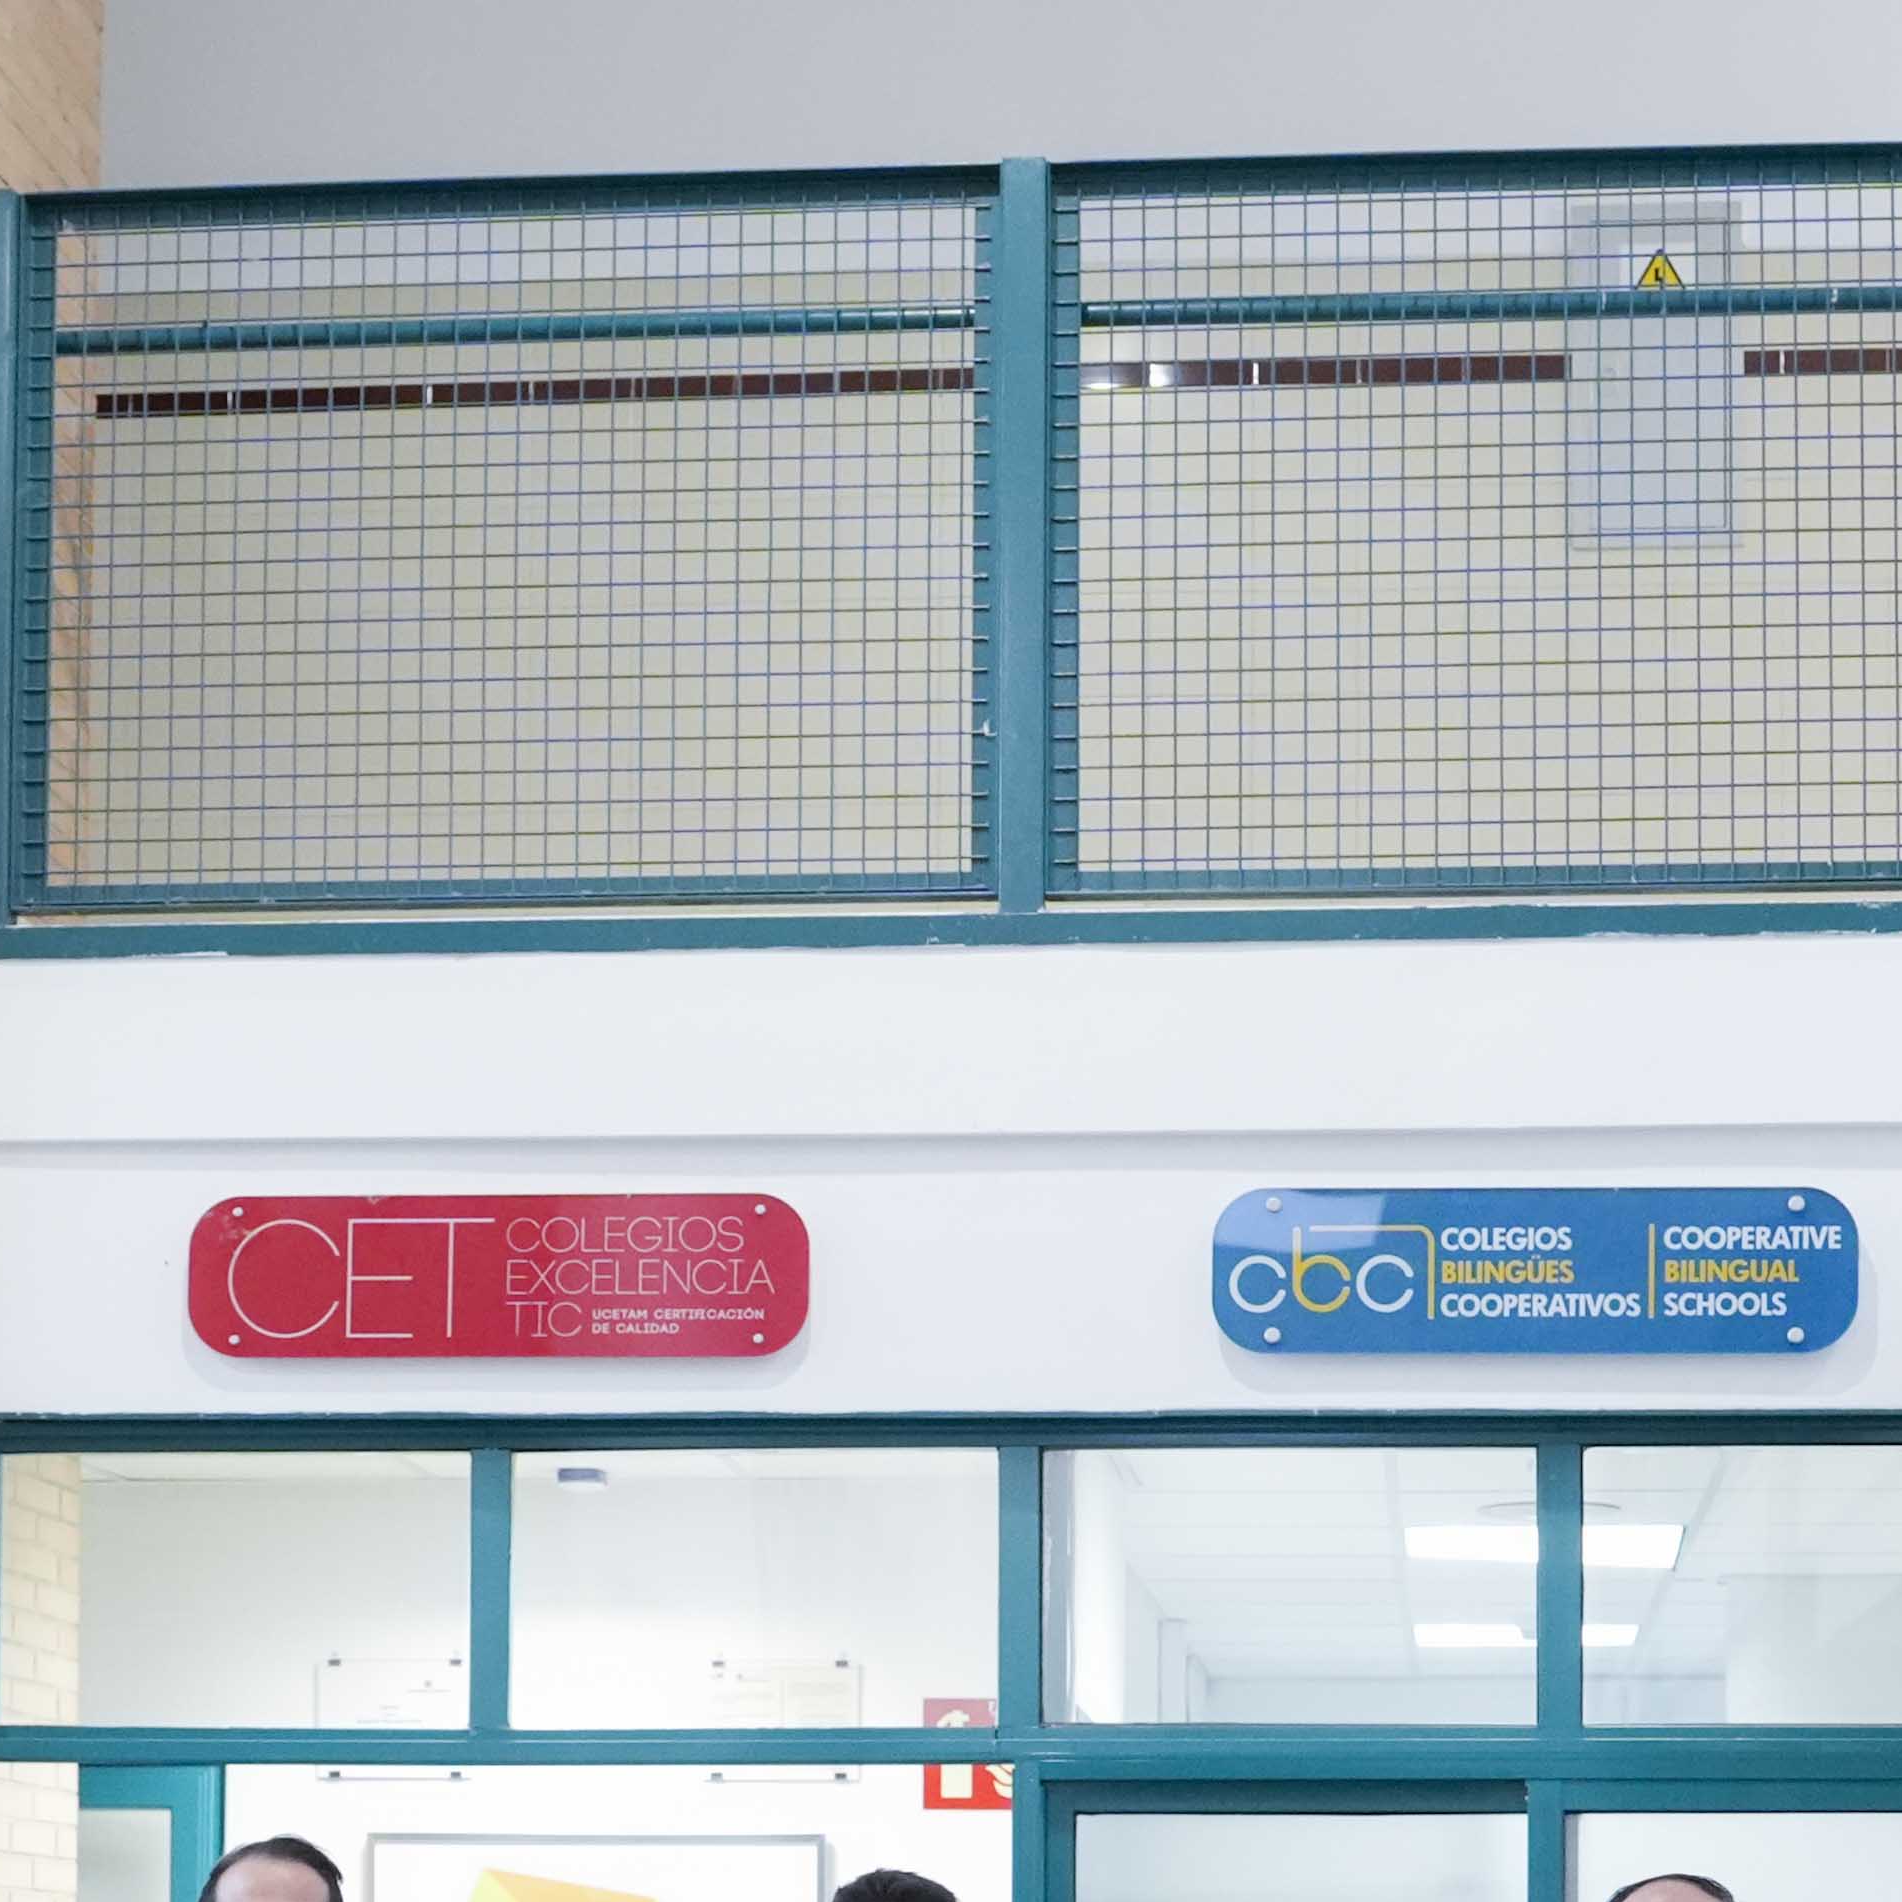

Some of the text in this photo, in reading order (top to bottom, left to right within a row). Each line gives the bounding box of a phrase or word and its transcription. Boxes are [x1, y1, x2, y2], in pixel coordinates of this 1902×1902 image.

[505, 1215, 744, 1254] COLEGIOS
[1440, 1226, 1573, 1252] COLEGIOS
[1663, 1225, 1842, 1251] COOPERATIVE
[227, 1218, 496, 1339] CET
[505, 1258, 775, 1296] EXCELENCIA
[1441, 1254, 1575, 1284] BILINGÜES
[1663, 1258, 1799, 1283] BILINGUAL
[592, 1306, 765, 1321] UCETAM CERTIFICACIÓN
[1440, 1292, 1642, 1318] COOPERATIVOS
[1663, 1291, 1788, 1317] SCHOOLS
[505, 1301, 583, 1338] TIC
[592, 1323, 680, 1334] DE CALIDAD
